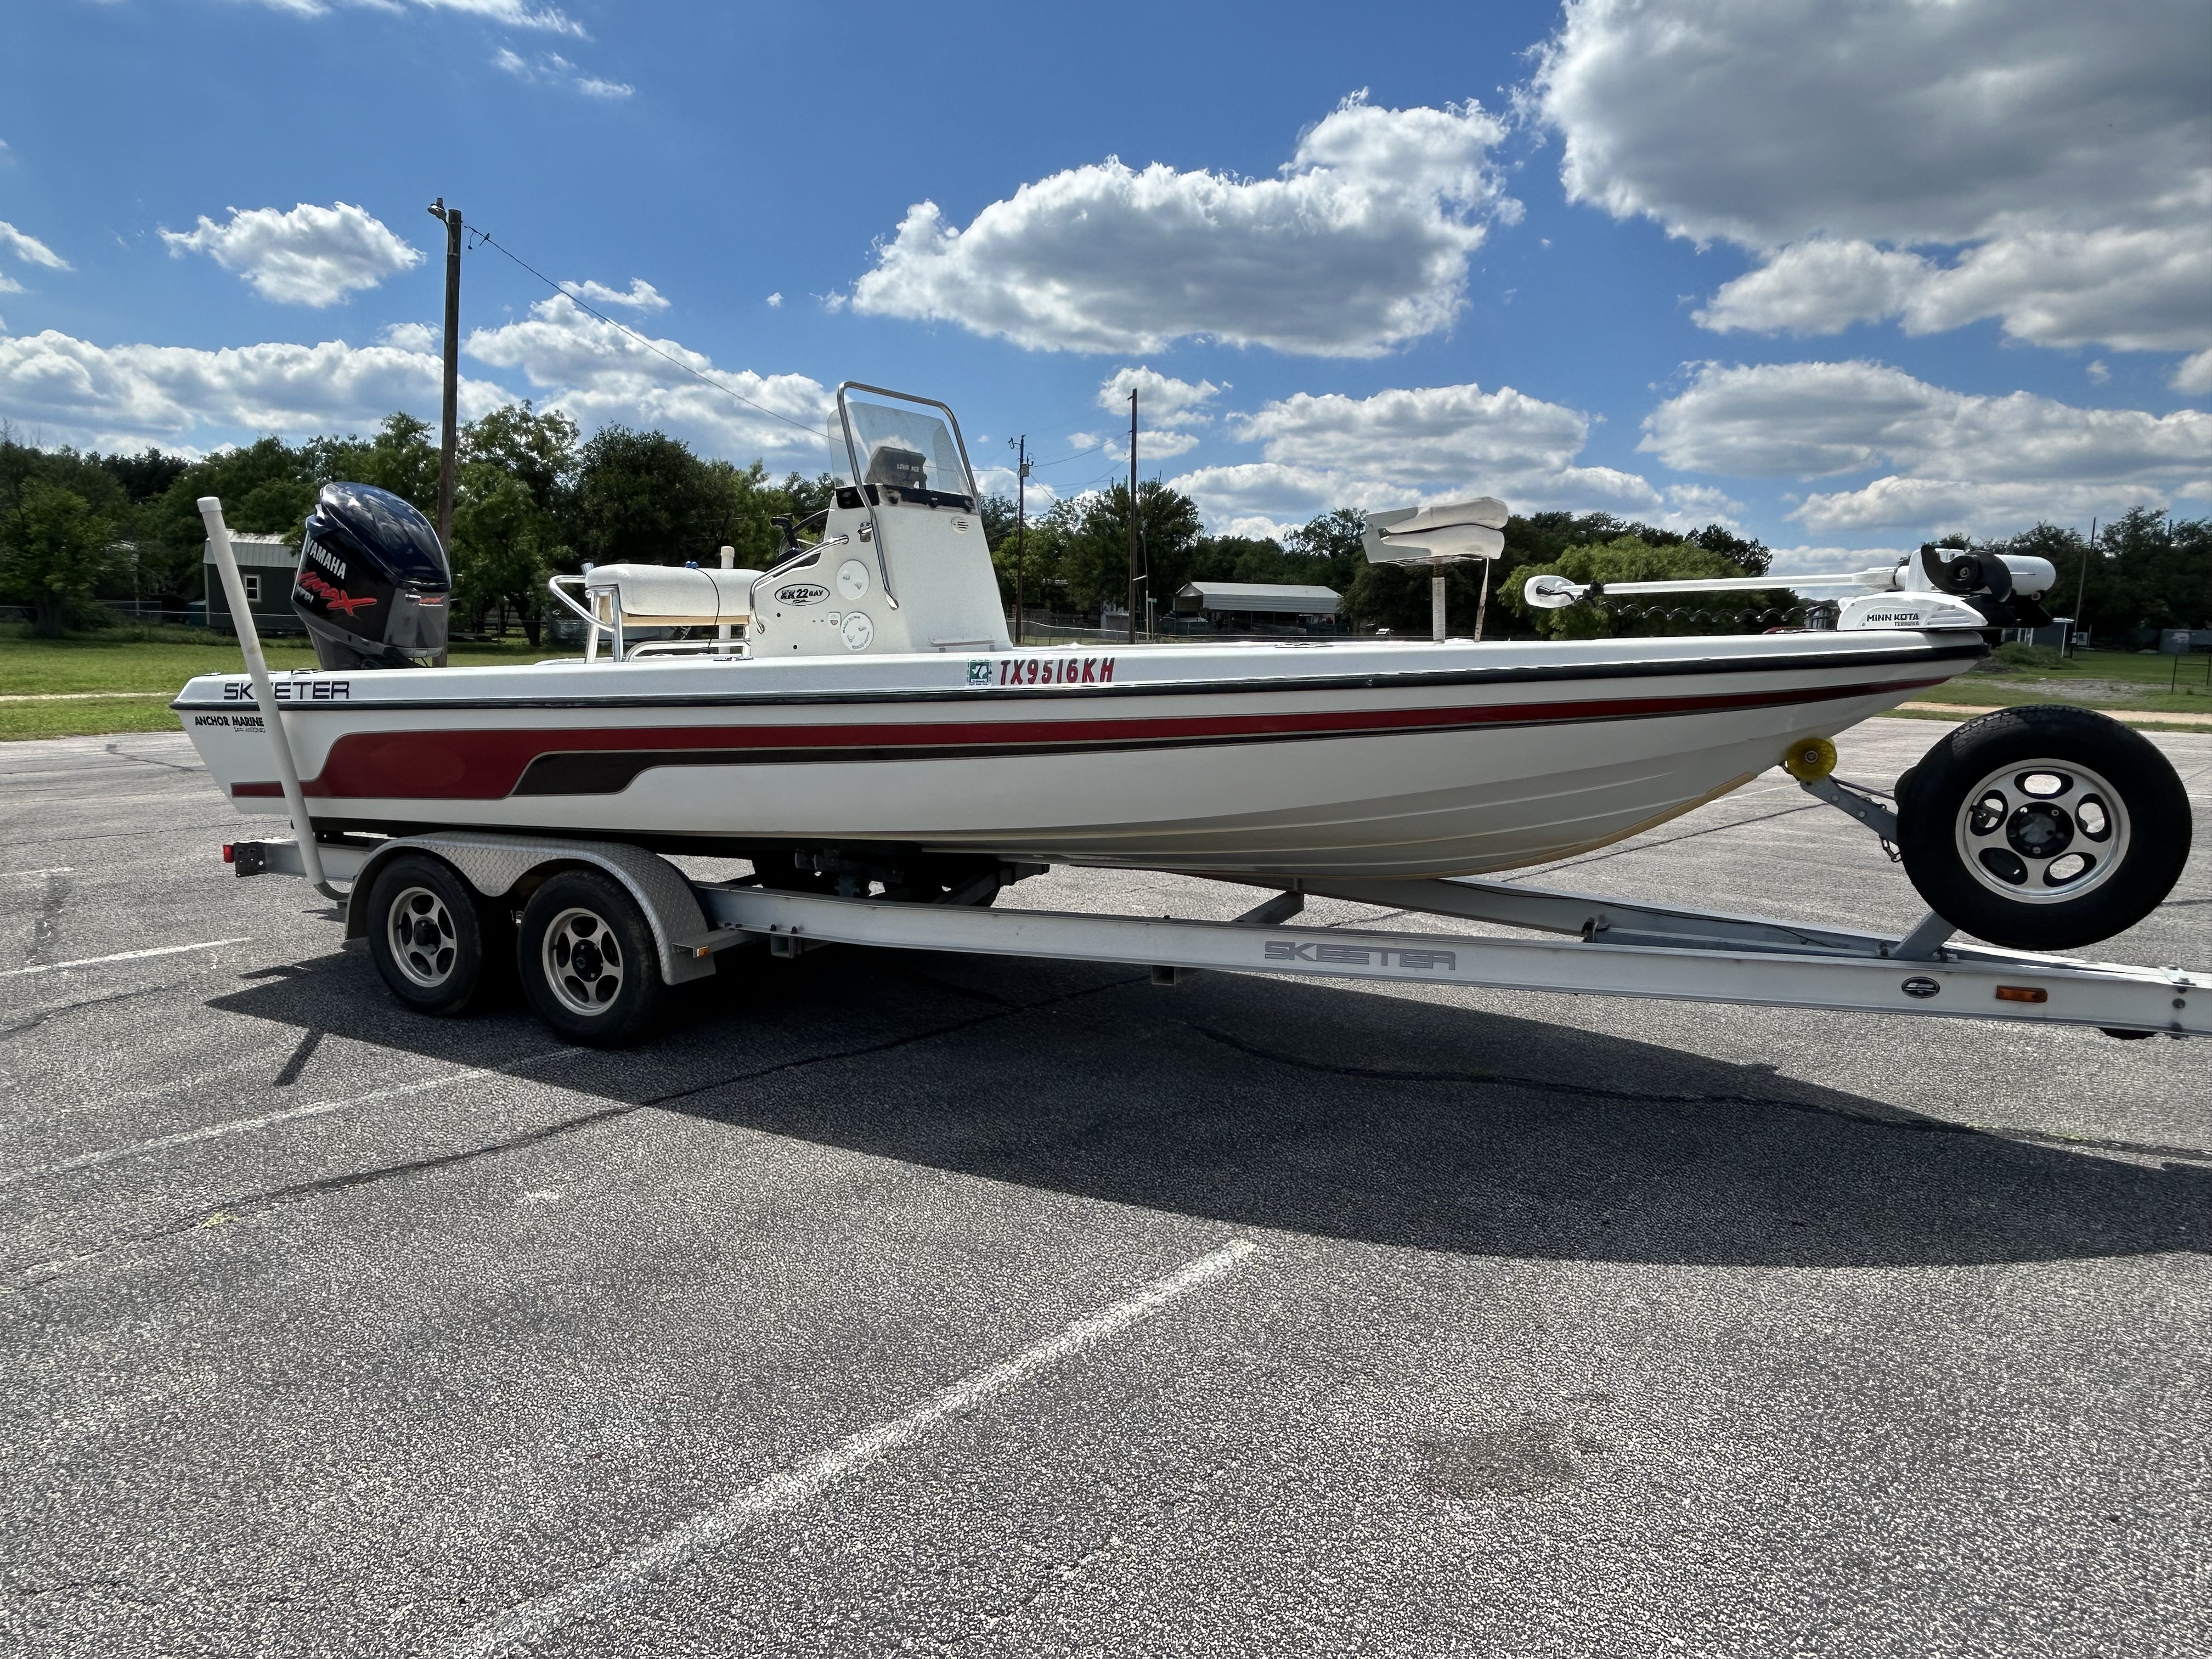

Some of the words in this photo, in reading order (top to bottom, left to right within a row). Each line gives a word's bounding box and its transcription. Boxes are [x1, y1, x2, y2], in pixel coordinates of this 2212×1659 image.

[307, 537, 347, 579] YAMAHA
[1867, 614, 1892, 622] MINN
[1894, 613, 1920, 621] KOTA
[1000, 657, 1115, 685] TX9516KH
[223, 681, 349, 700] SKETER
[195, 716, 230, 726] ANCHOR
[232, 716, 264, 727] MARINE
[1265, 940, 1455, 970] SKEETER
